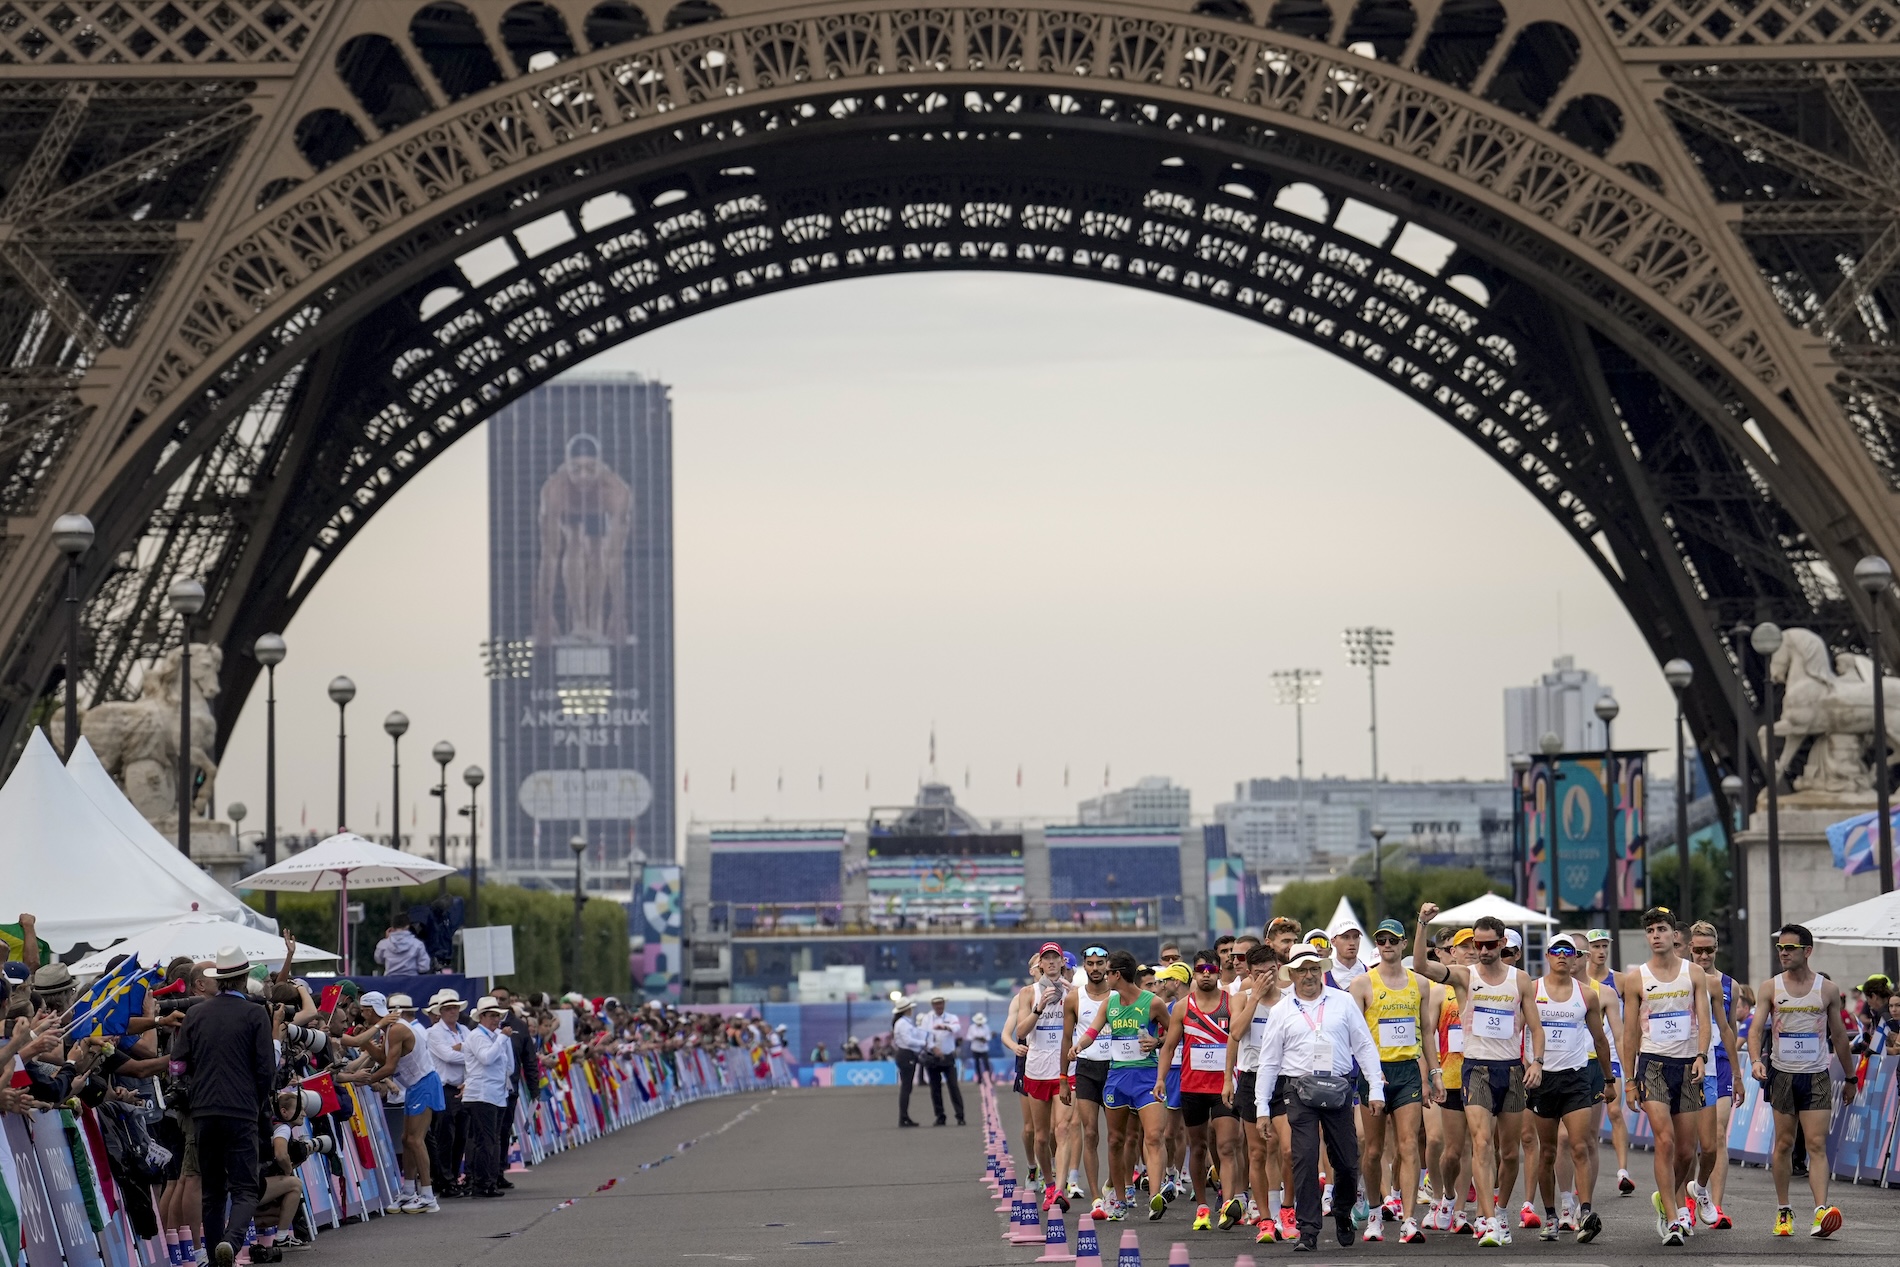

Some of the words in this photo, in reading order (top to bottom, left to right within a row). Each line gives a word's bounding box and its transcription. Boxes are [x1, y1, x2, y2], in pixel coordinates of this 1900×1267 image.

[597, 708, 649, 727] DEUX
[554, 728, 609, 747] PARIS
[1541, 1010, 1575, 1018] ECUADOR
[1112, 1018, 1140, 1030] BRASIL
[1488, 1016, 1500, 1026] 33
[1664, 1020, 1677, 1029] 34
[1394, 1025, 1406, 1034] 10
[1552, 1029, 1563, 1039] 27
[1048, 1032, 1057, 1040] 18
[1099, 1041, 1110, 1050] 48
[1122, 1042, 1131, 1050] 15
[1794, 1041, 1804, 1050] 31
[1204, 1051, 1215, 1059] 67
[1047, 1231, 1065, 1239] 2024
[1078, 1243, 1097, 1251] 2024
[1119, 1255, 1141, 1263] PARIS
